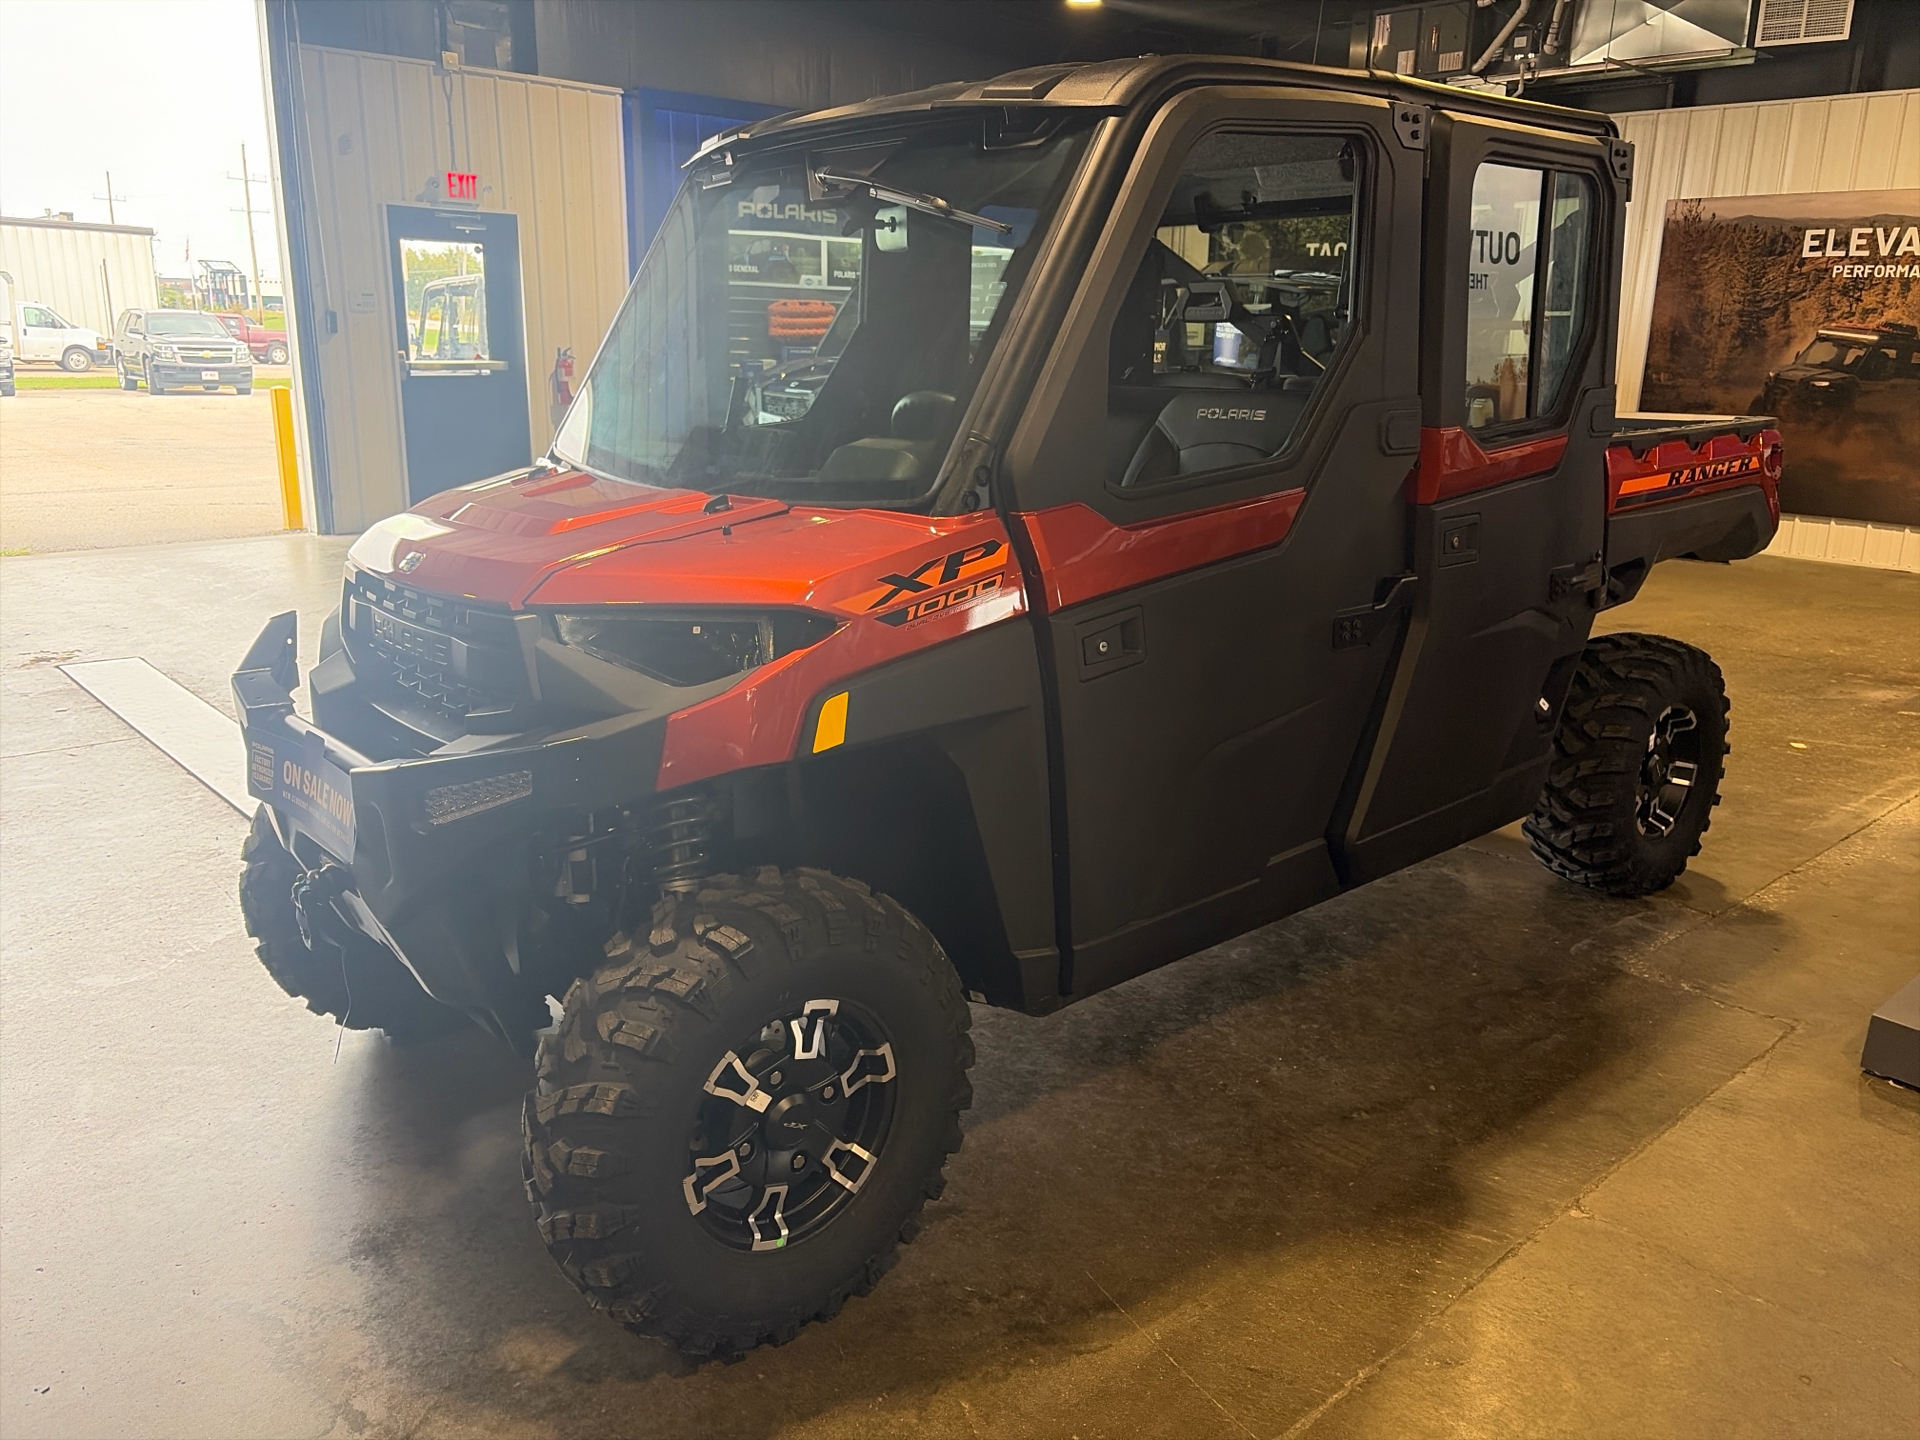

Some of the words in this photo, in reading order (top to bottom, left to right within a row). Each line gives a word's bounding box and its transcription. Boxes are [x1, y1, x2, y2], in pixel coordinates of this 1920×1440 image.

[447, 171, 477, 199] EXIT
[738, 201, 837, 224] POLARIS
[1802, 227, 1920, 258] ELEVA
[1832, 264, 1920, 278] PERFORMA
[1197, 408, 1266, 421] POLARIS
[1667, 456, 1752, 487] RANGER
[865, 538, 1002, 611] XP
[906, 574, 1003, 622] 1000
[283, 760, 301, 790] ON
[303, 770, 330, 810] SALE
[329, 788, 352, 827] NOW
